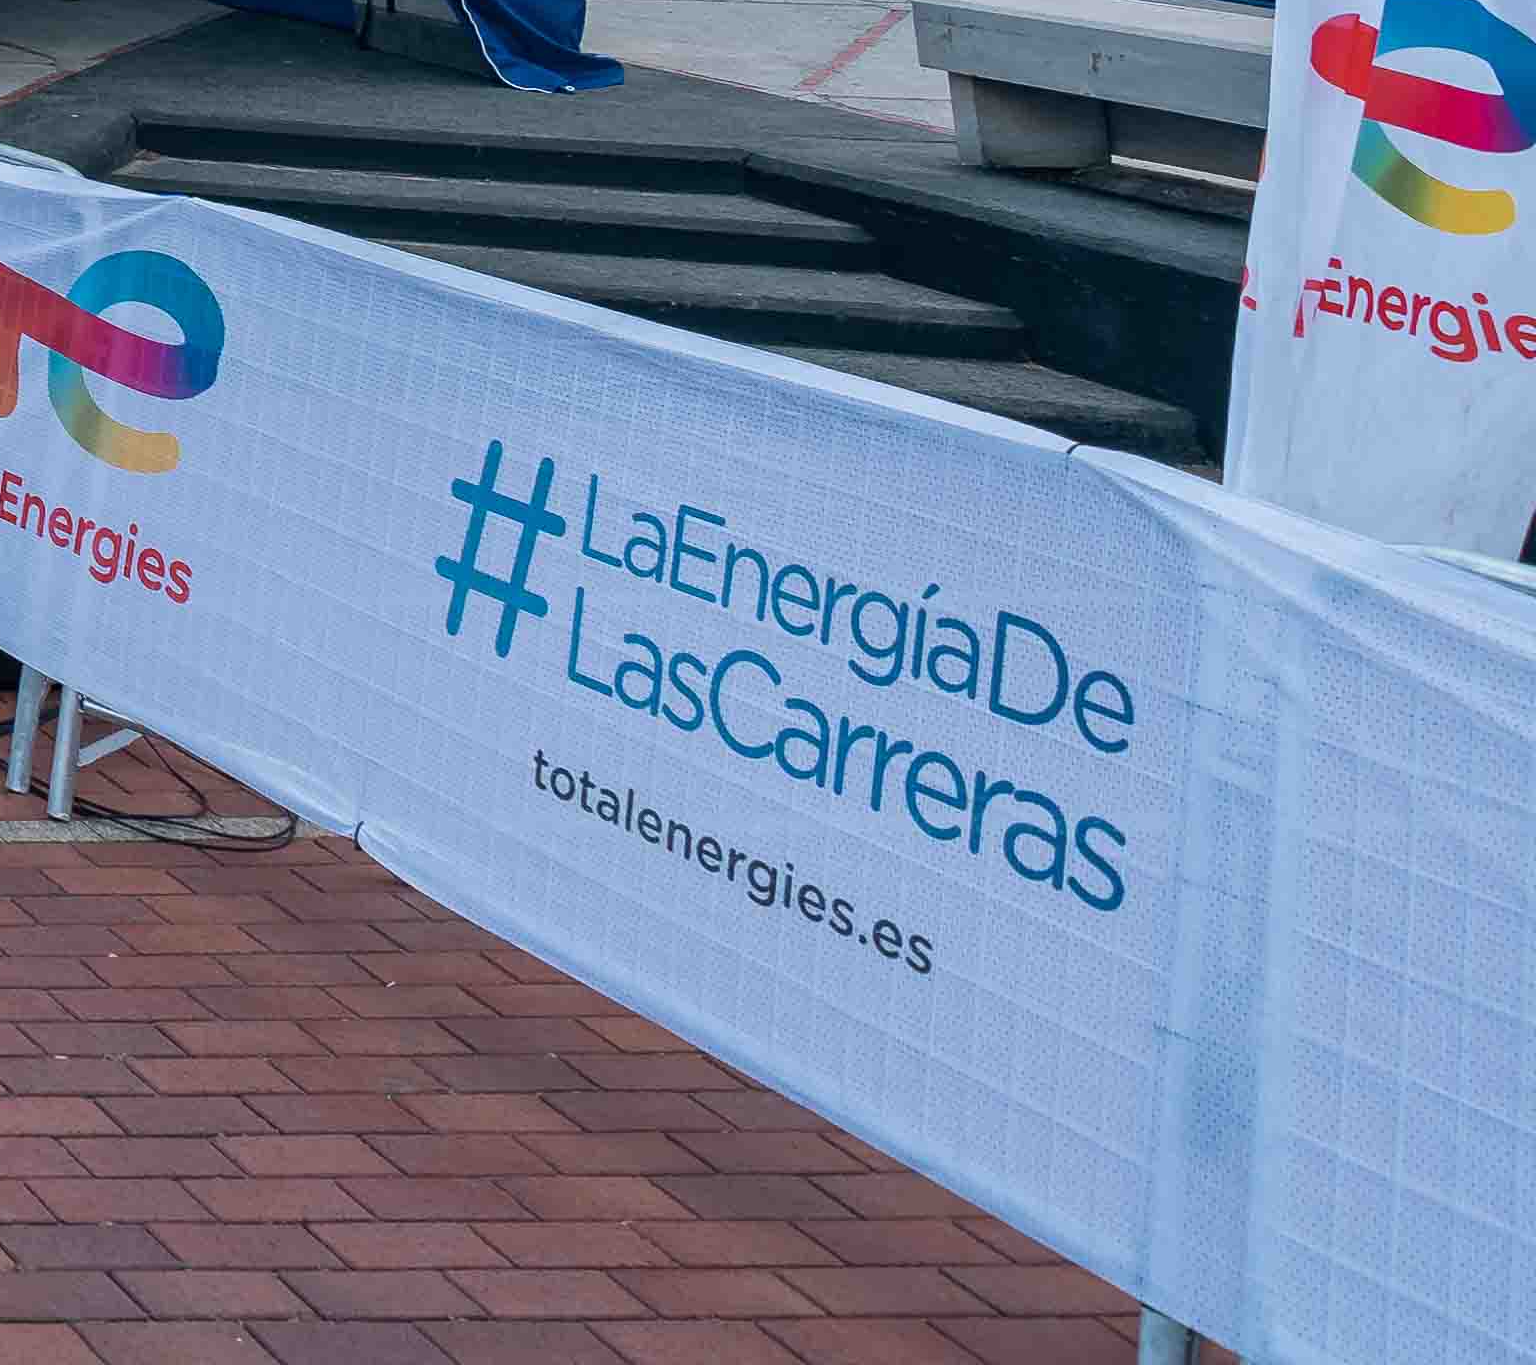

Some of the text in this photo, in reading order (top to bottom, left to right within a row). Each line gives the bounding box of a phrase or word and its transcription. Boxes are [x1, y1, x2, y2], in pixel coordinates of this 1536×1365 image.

[568, 586, 1128, 912] LasCarreras
[581, 473, 1134, 753] LaEnergíaDe
[532, 749, 935, 974] totalenergies.es
